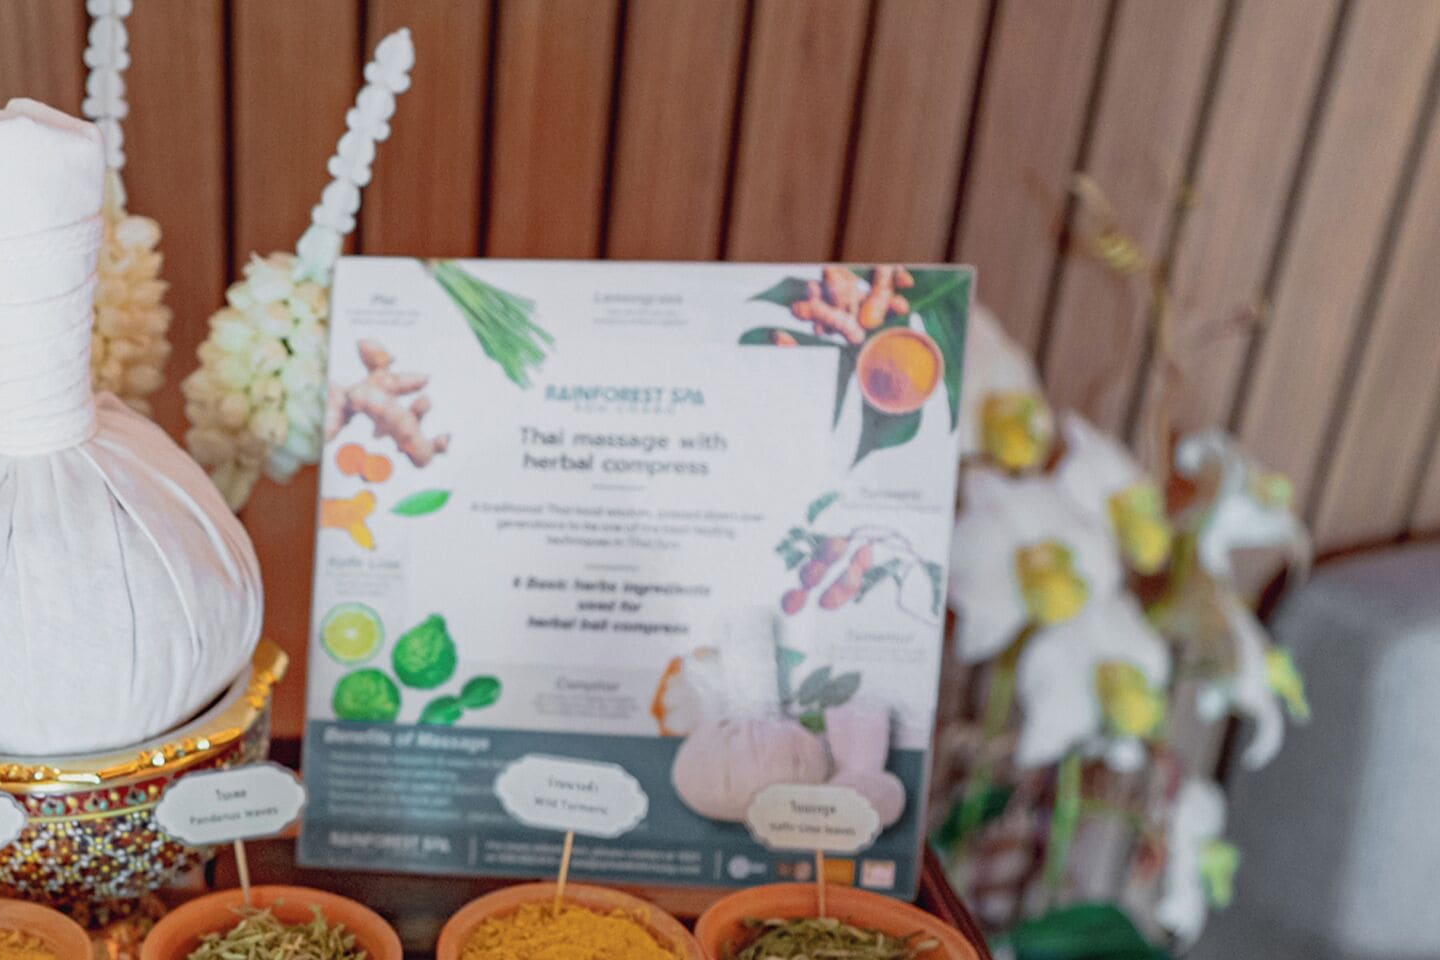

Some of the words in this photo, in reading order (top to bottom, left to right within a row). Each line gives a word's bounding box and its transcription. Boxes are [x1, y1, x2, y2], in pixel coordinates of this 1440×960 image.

[544, 384, 664, 403] RAINFOREST
[671, 387, 705, 405] SPA
[520, 427, 564, 446] Thai
[572, 433, 669, 453] massage
[680, 432, 728, 450] with
[522, 452, 594, 470] herbal
[601, 457, 710, 476] compress
[527, 577, 567, 590] Basic
[574, 578, 617, 592] herbs
[623, 581, 711, 597] ingredients
[577, 601, 614, 612] used
[621, 601, 642, 612] for
[528, 616, 576, 630] herbal
[613, 621, 690, 635] compress
[395, 729, 415, 747] of
[417, 730, 492, 755] Massage
